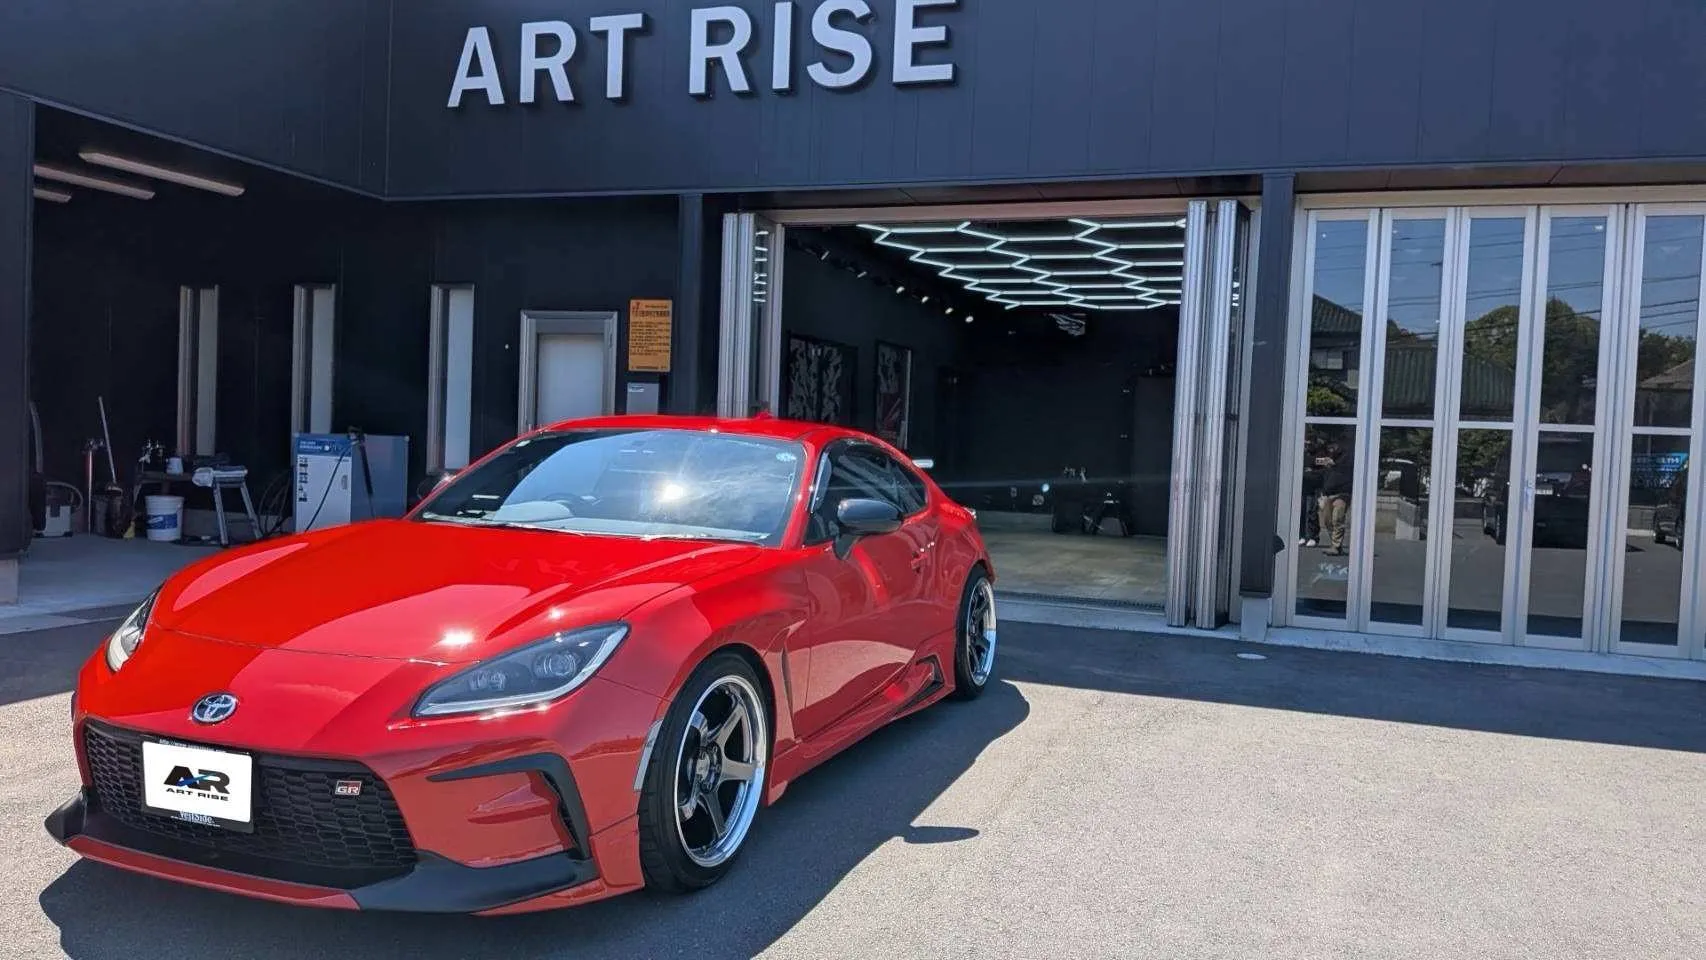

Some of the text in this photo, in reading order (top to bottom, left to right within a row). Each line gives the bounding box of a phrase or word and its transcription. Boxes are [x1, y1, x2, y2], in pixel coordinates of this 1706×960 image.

[447, 0, 957, 108] ART RISE
[166, 787, 229, 802] ART RISE
[337, 786, 359, 794] GR
